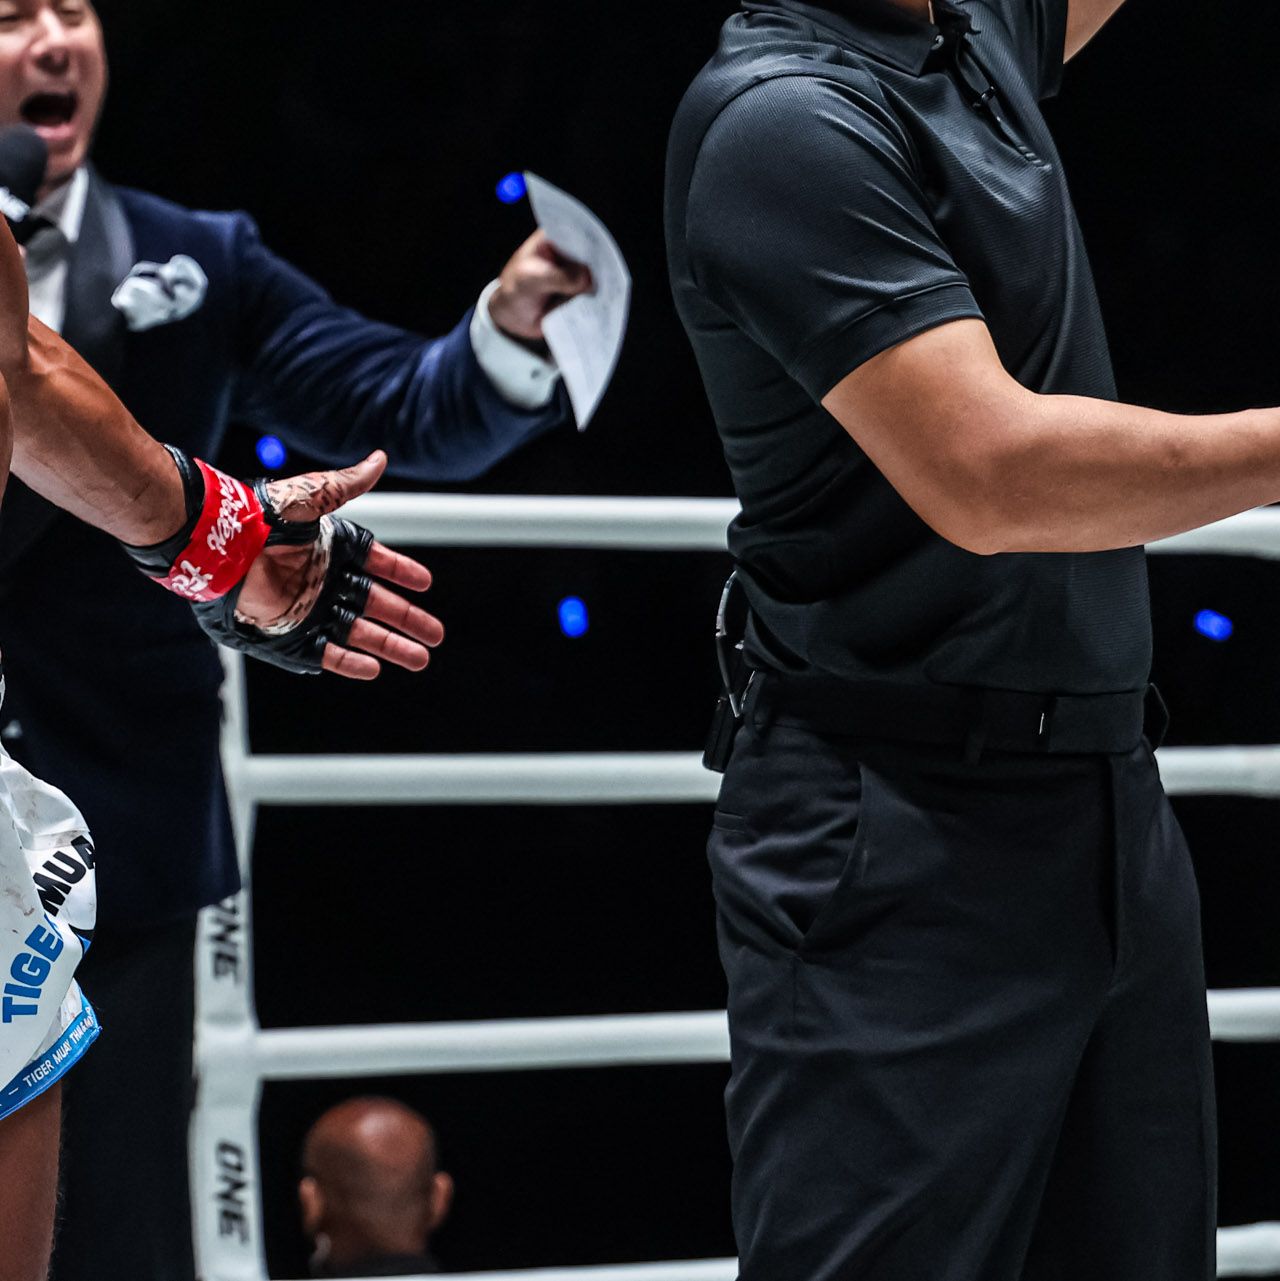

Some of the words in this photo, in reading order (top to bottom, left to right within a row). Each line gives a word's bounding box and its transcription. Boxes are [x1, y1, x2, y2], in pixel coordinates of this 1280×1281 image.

[32, 835, 96, 917] MUA
[22, 1059, 55, 1088] TIGER
[213, 1138, 251, 1247] ONE
